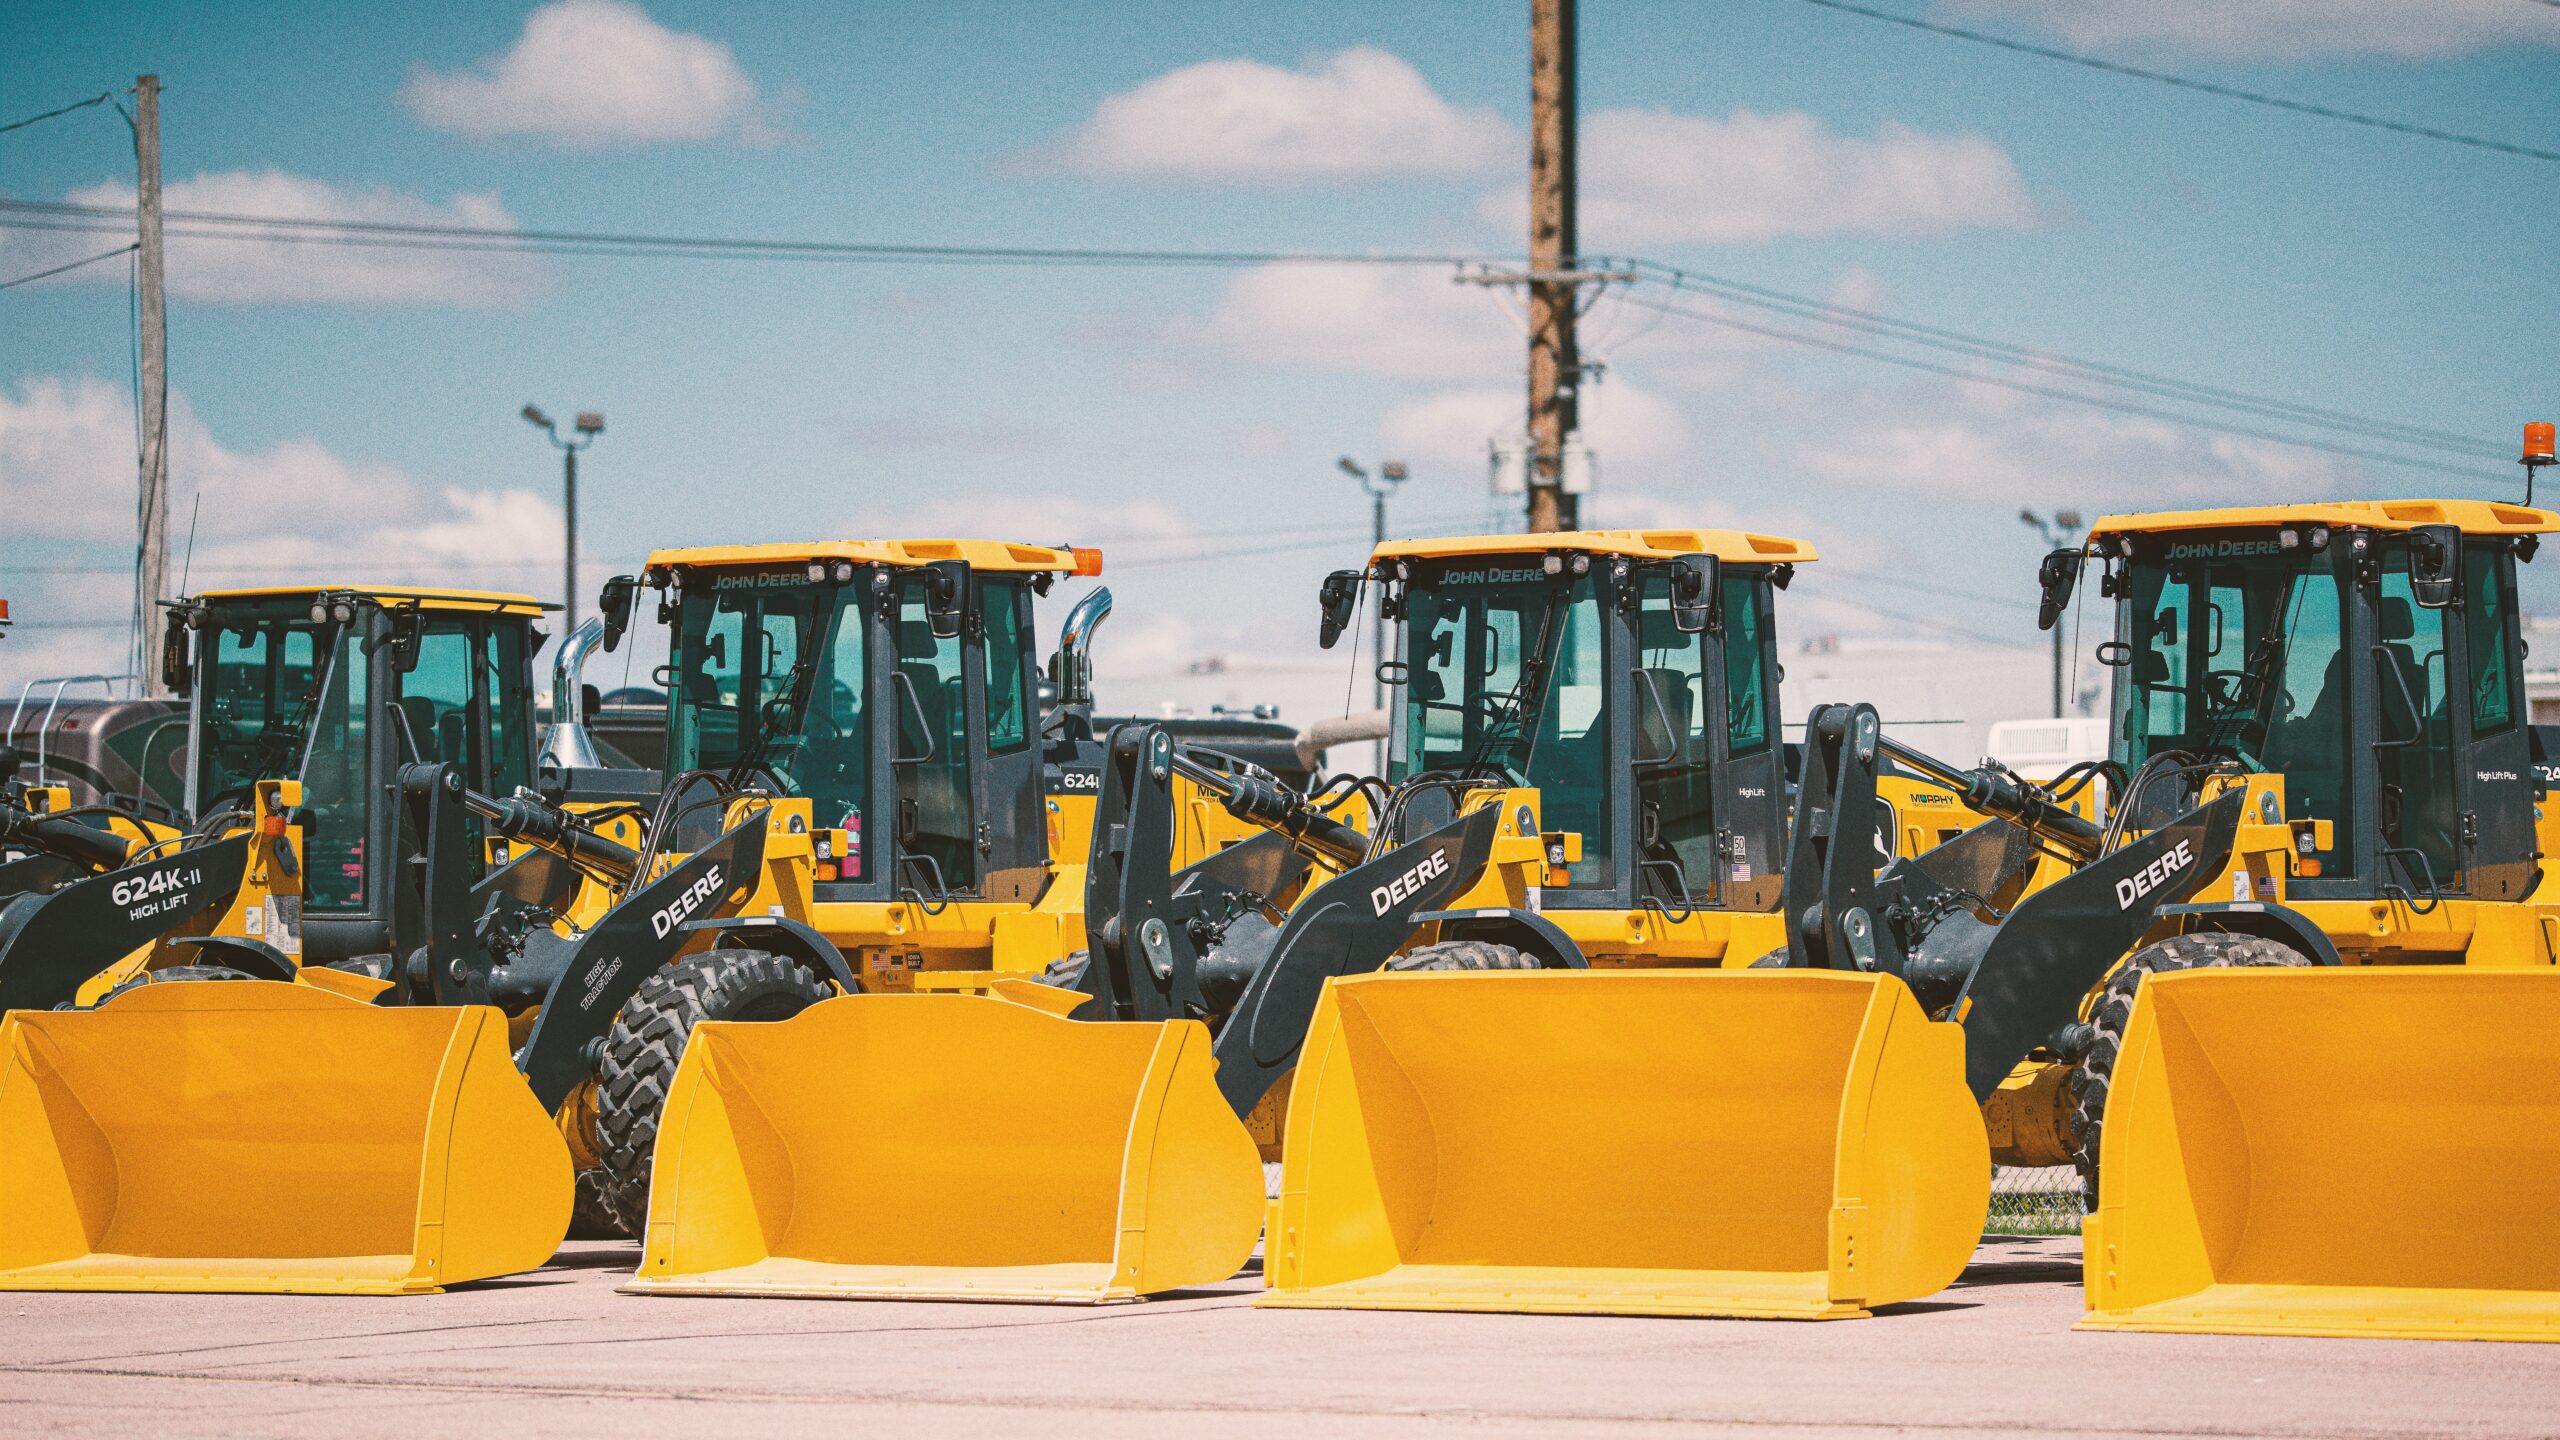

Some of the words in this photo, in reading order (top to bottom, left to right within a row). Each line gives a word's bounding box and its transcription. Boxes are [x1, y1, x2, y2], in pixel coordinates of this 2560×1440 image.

[2164, 542, 2215, 559] JOHN
[2218, 540, 2280, 556] DEERE
[711, 575, 755, 590] JOHN
[1438, 569, 1485, 585] JOHN
[1488, 567, 1545, 583] DEERE
[2504, 771, 2518, 780] Plus
[1734, 838, 1745, 850] 50
[111, 867, 201, 906] 624K-II
[1370, 847, 1450, 918] DEERE
[2115, 838, 2194, 912] DEERE
[129, 903, 160, 921] HIGH
[162, 892, 189, 911] LIFT
[651, 864, 725, 940] DEERE
[580, 956, 623, 1011] TRACTION
[583, 957, 607, 988] HIGH
